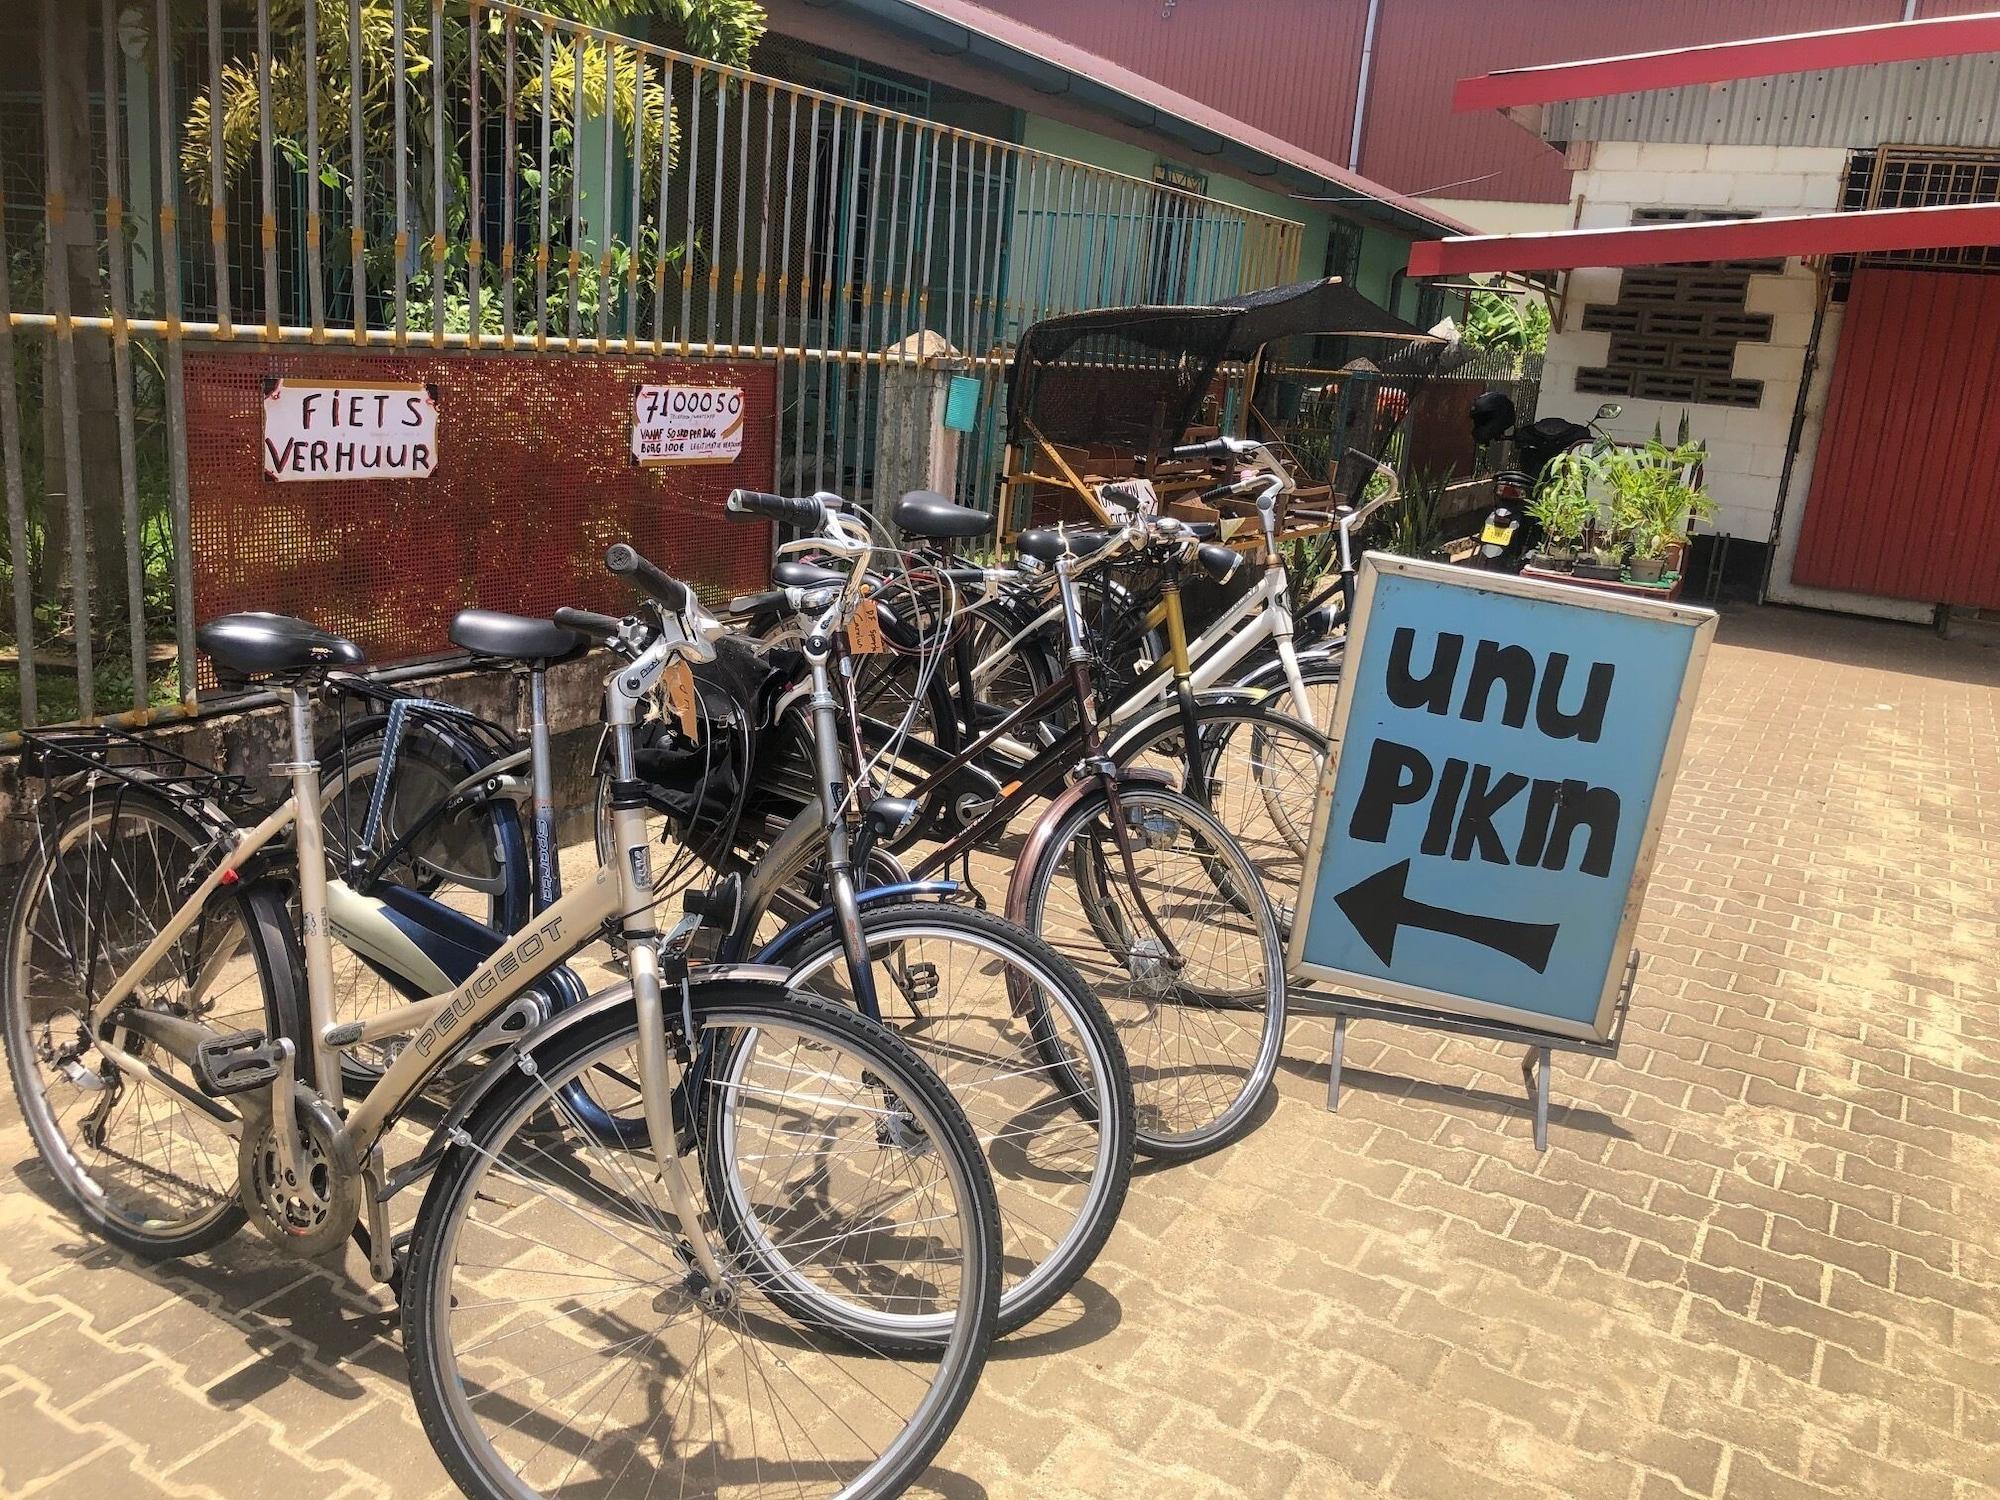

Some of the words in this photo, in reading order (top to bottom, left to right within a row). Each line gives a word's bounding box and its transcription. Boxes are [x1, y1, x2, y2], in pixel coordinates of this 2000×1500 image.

[646, 388, 741, 424] 7100050
[640, 428, 665, 440] VANAF
[666, 427, 677, 439] 50
[689, 428, 702, 440] PER
[702, 427, 717, 439] DAG
[640, 442, 661, 453] BORG
[664, 442, 685, 453] 100€
[265, 436, 430, 474] VERHUUR
[536, 818, 553, 903] Sparta
[415, 916, 563, 1058] PEUGEOT
